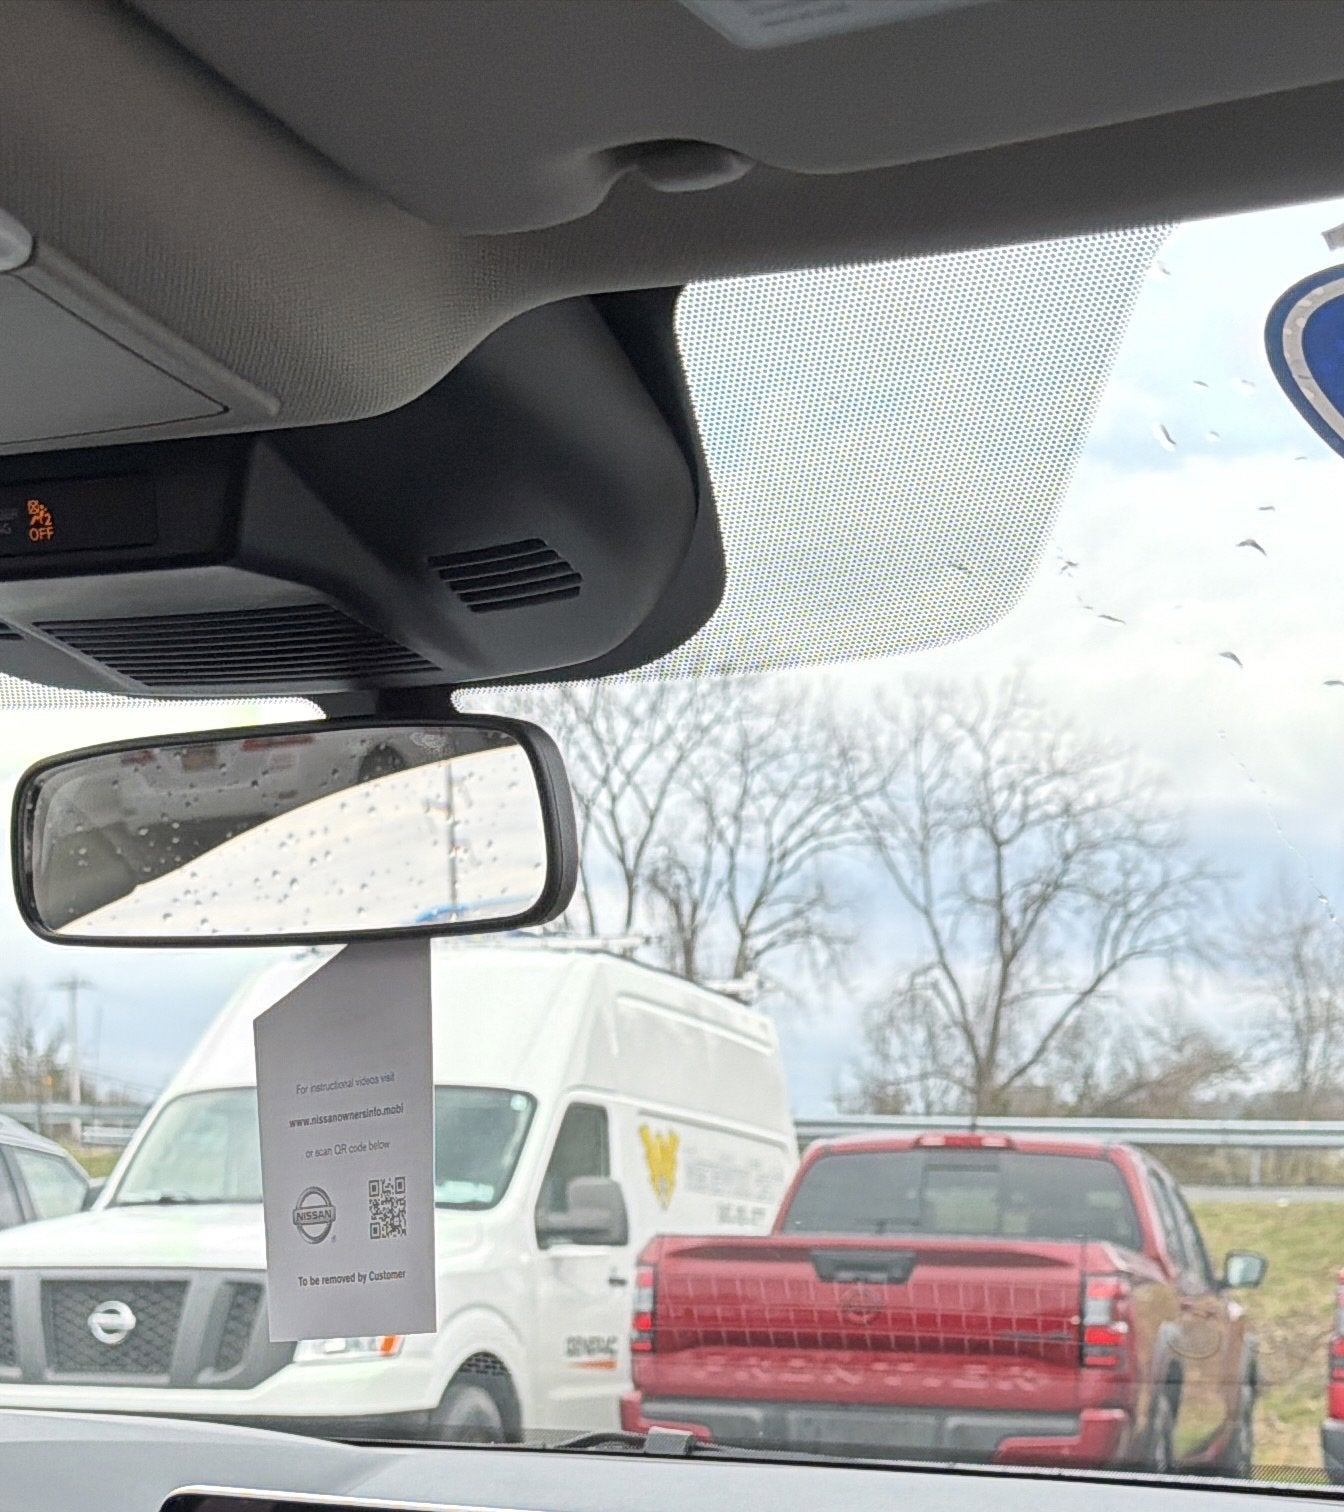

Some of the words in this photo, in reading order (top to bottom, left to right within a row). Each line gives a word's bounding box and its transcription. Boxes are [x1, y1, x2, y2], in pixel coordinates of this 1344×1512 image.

[28, 527, 54, 541] OFF
[296, 1084, 308, 1095] For
[310, 1079, 353, 1093] instructional
[356, 1075, 379, 1087] videos
[305, 1150, 313, 1158] or
[315, 1148, 332, 1157] scan
[334, 1143, 346, 1155] QR
[348, 1141, 367, 1153] code
[368, 1140, 390, 1151] below
[296, 1210, 332, 1221] NISSAN
[298, 1277, 308, 1287] To
[310, 1276, 319, 1286] be
[321, 1273, 355, 1285] removed
[358, 1272, 367, 1284] by
[369, 1271, 405, 1282] Customer
